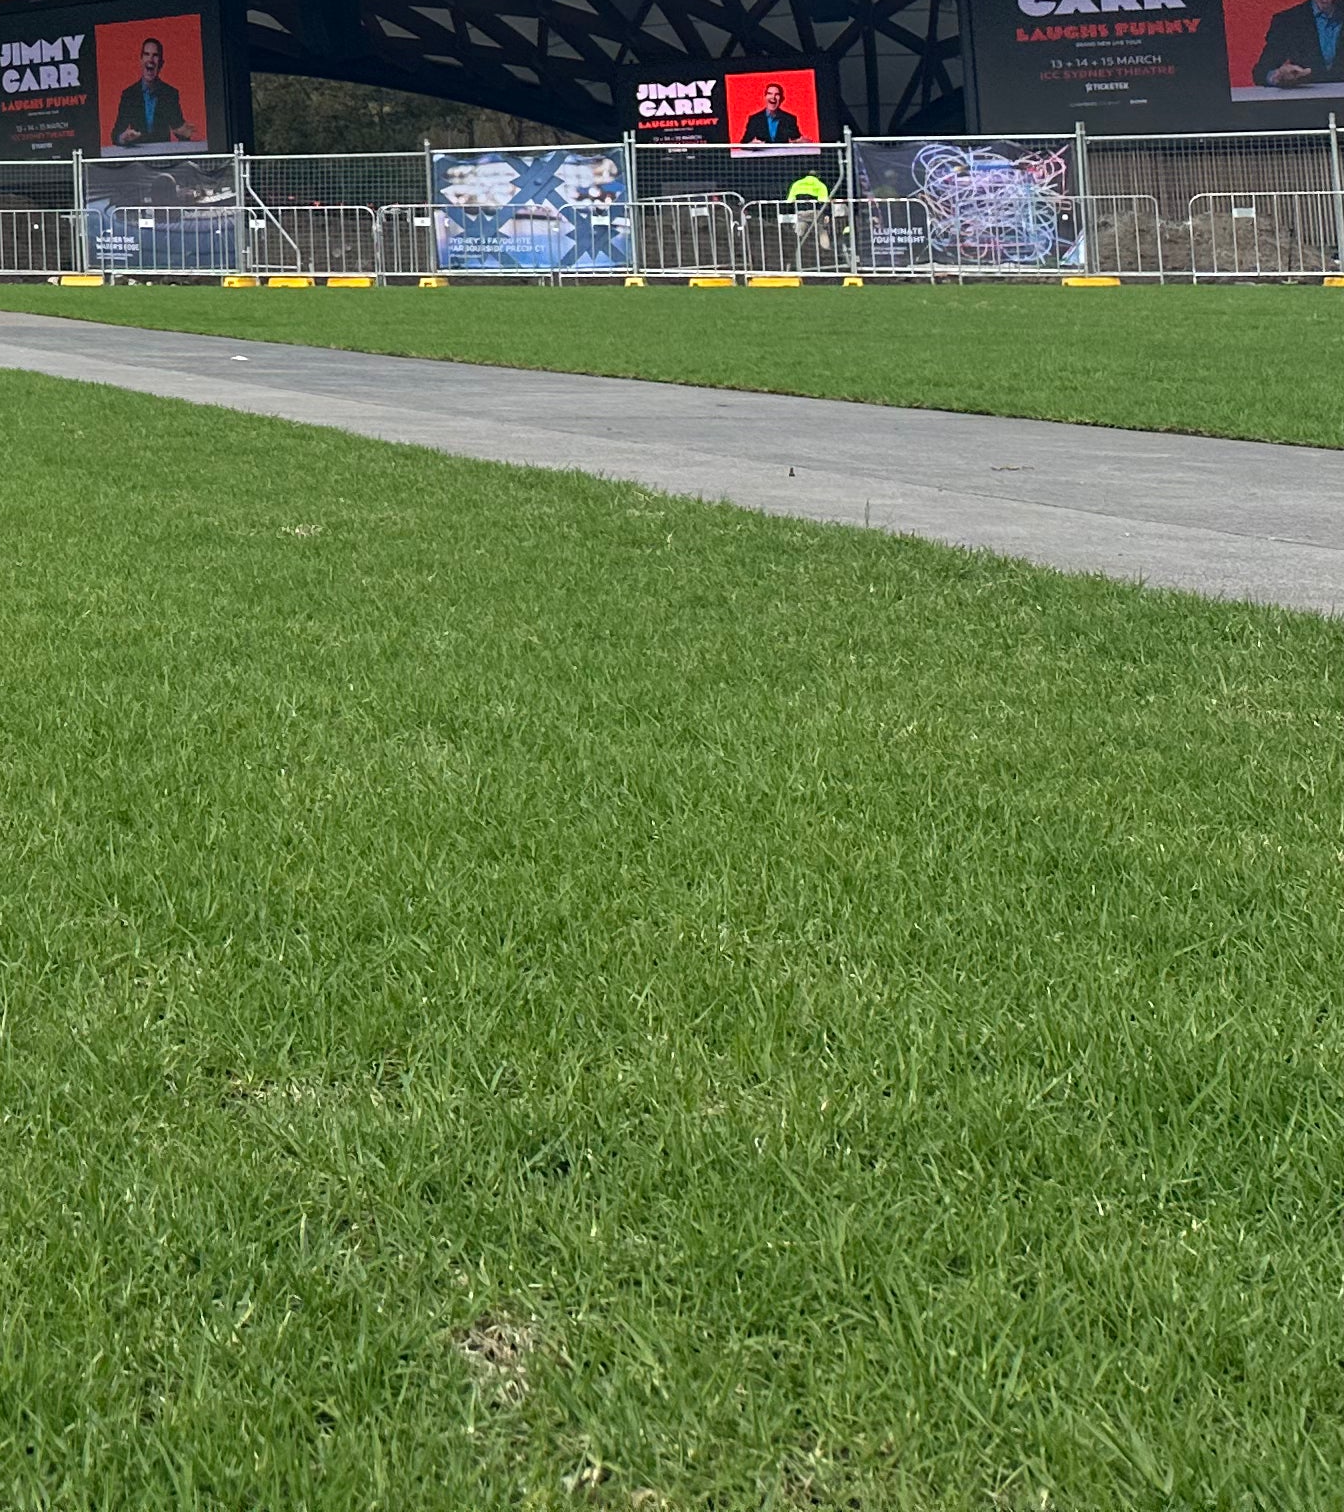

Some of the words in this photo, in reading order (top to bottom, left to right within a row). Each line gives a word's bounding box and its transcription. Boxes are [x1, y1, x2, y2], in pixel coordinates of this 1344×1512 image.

[1016, 24, 1109, 41] LAUGHS
[1115, 18, 1201, 36] FUNNY
[0, 34, 85, 67] JIMMY
[1051, 59, 1062, 68] 13
[1076, 58, 1088, 67] 14
[1102, 57, 1114, 66] 15
[1116, 55, 1162, 65] MARCH
[2, 64, 80, 94] CARR
[1063, 68, 1112, 80] SYDNEY
[1115, 66, 1175, 76] THEATRE
[636, 80, 716, 100] JIMMY
[639, 98, 713, 117] CARR
[873, 227, 923, 235] LLUMINATE
